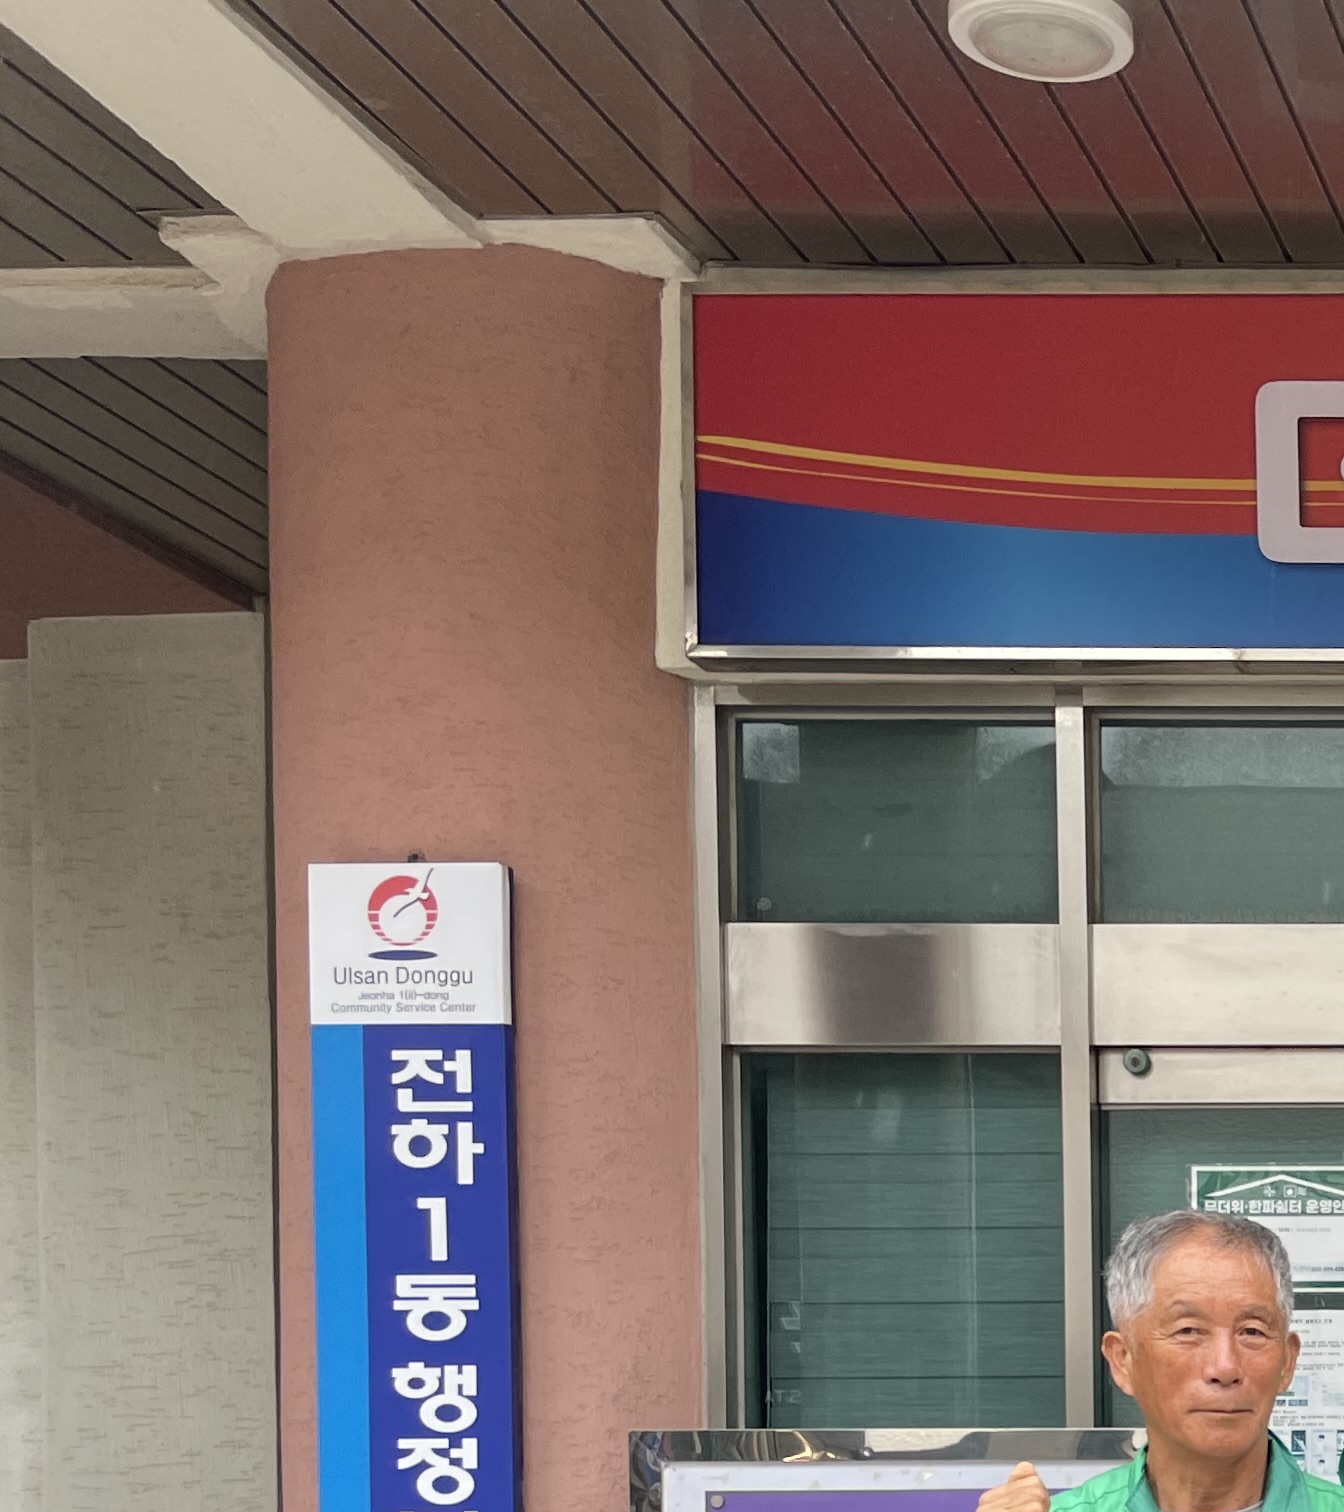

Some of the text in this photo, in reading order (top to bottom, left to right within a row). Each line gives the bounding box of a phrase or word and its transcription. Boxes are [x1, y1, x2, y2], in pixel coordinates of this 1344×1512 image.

[333, 967, 474, 987] Ulsan Donggu
[331, 1003, 476, 1014] Community Service Center
